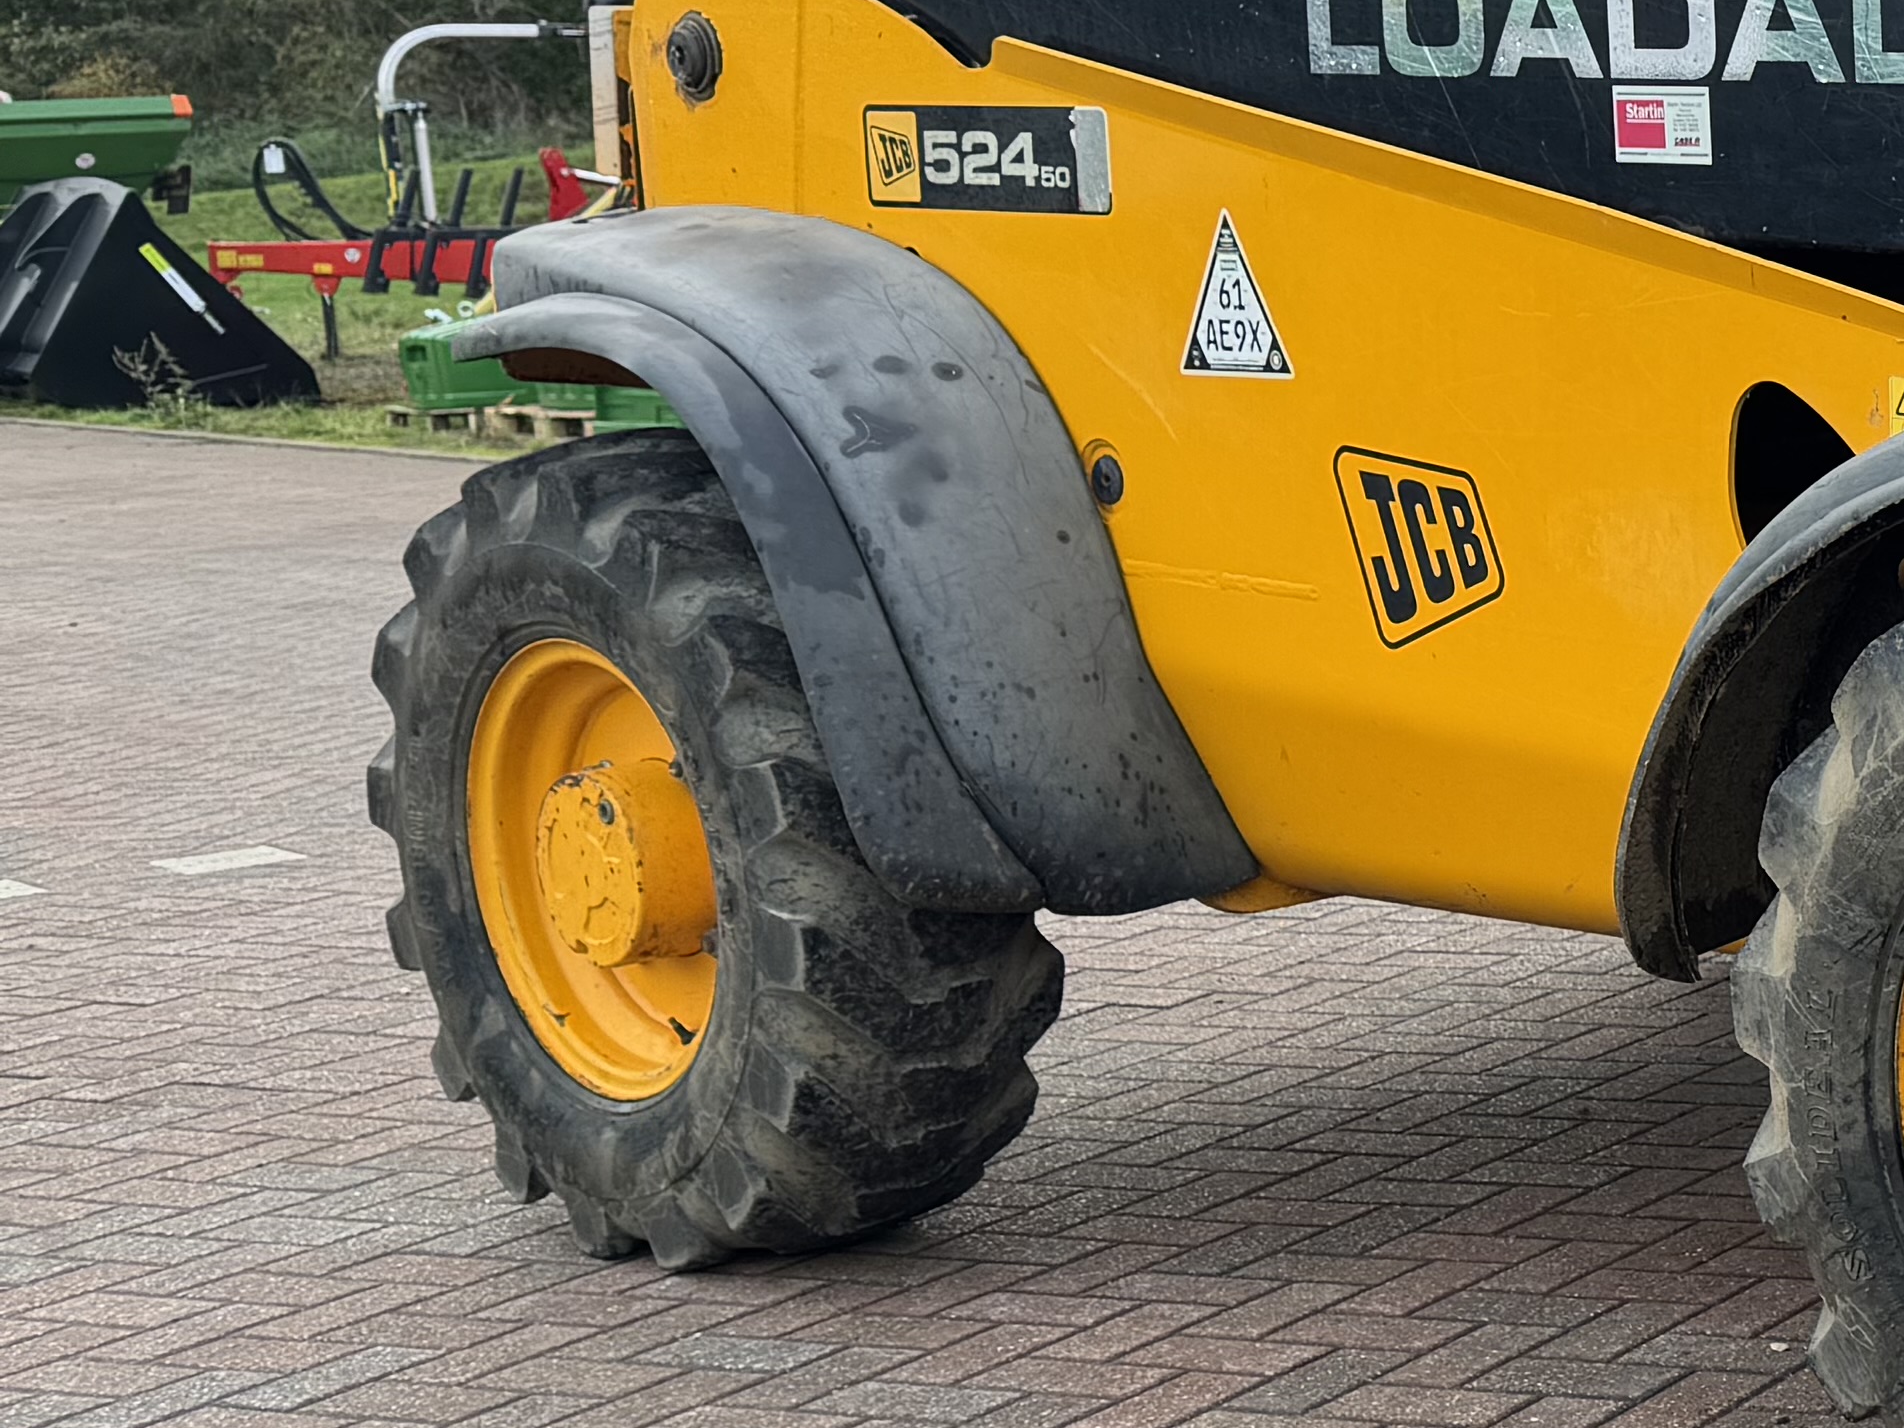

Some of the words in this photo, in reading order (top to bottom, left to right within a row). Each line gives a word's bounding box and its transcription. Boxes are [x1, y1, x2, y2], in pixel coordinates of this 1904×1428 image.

[1625, 102, 1665, 119] Startin
[878, 132, 912, 180] JCB
[923, 130, 1039, 188] 524
[1040, 165, 1071, 189] 50
[1218, 277, 1246, 311] 61
[1206, 318, 1263, 354] AE9X
[1358, 469, 1489, 625] JCB
